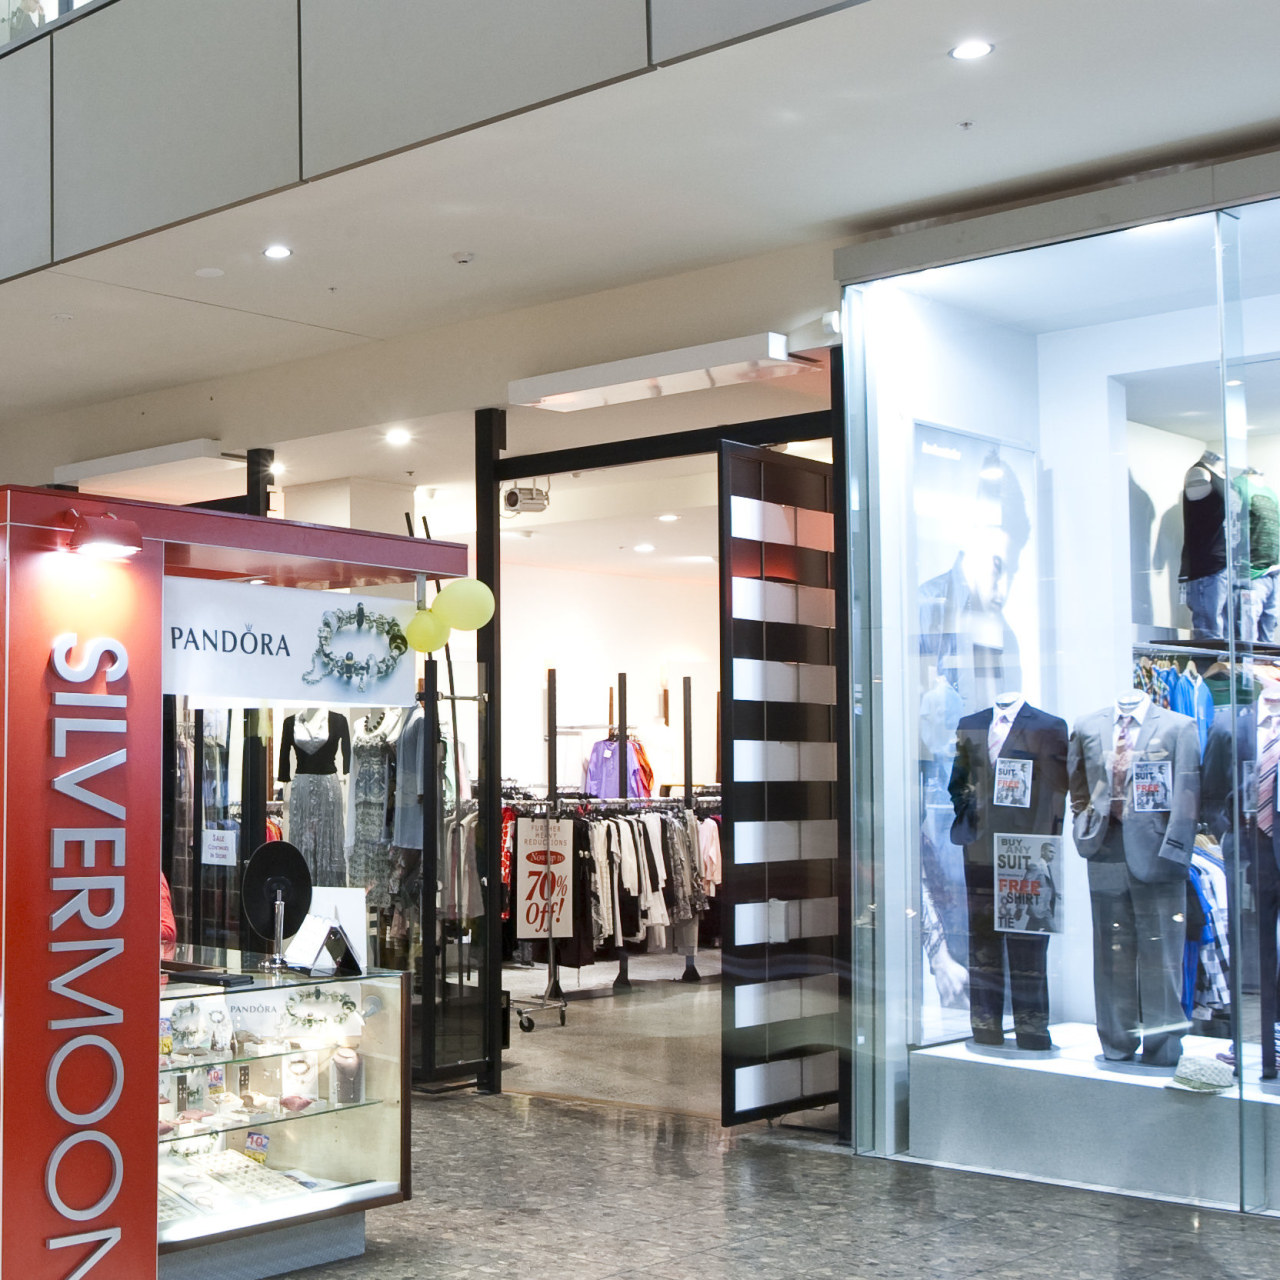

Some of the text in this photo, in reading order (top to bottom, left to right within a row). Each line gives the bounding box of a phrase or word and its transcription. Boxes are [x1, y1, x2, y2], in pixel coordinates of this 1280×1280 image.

[170, 624, 291, 657] PANDORA
[531, 824, 561, 832] FURHER
[524, 838, 568, 847] REDUCIONS
[1001, 838, 1023, 846] BUY
[1005, 846, 1032, 854] ANY
[997, 853, 1032, 870] SUIT
[525, 870, 568, 901] 70%
[998, 878, 1041, 895] FREE
[1006, 891, 1041, 906] SHIRT
[997, 916, 1016, 929] TIE
[230, 1003, 278, 1014] PANDORA
